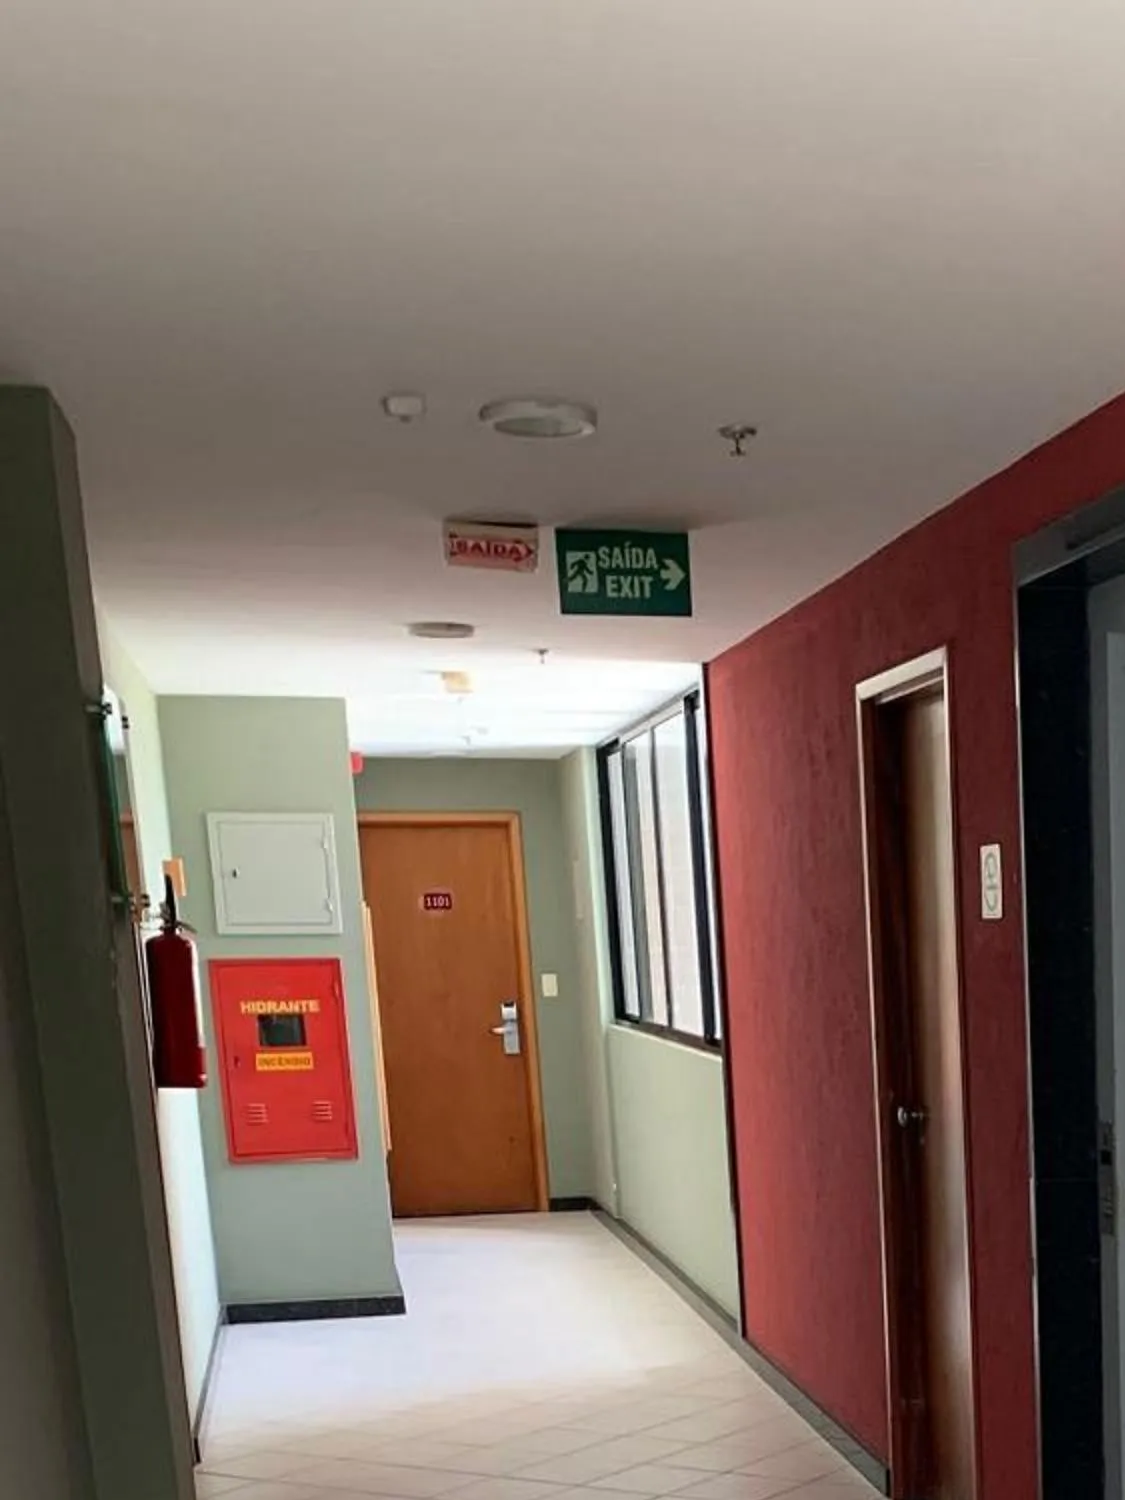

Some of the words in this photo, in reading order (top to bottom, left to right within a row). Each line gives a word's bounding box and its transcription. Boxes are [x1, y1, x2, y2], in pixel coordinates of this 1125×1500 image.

[598, 541, 658, 569] SAÍDA
[605, 575, 653, 599] EXIT
[426, 896, 449, 907] 1101
[240, 1000, 321, 1014] HIDRANTE
